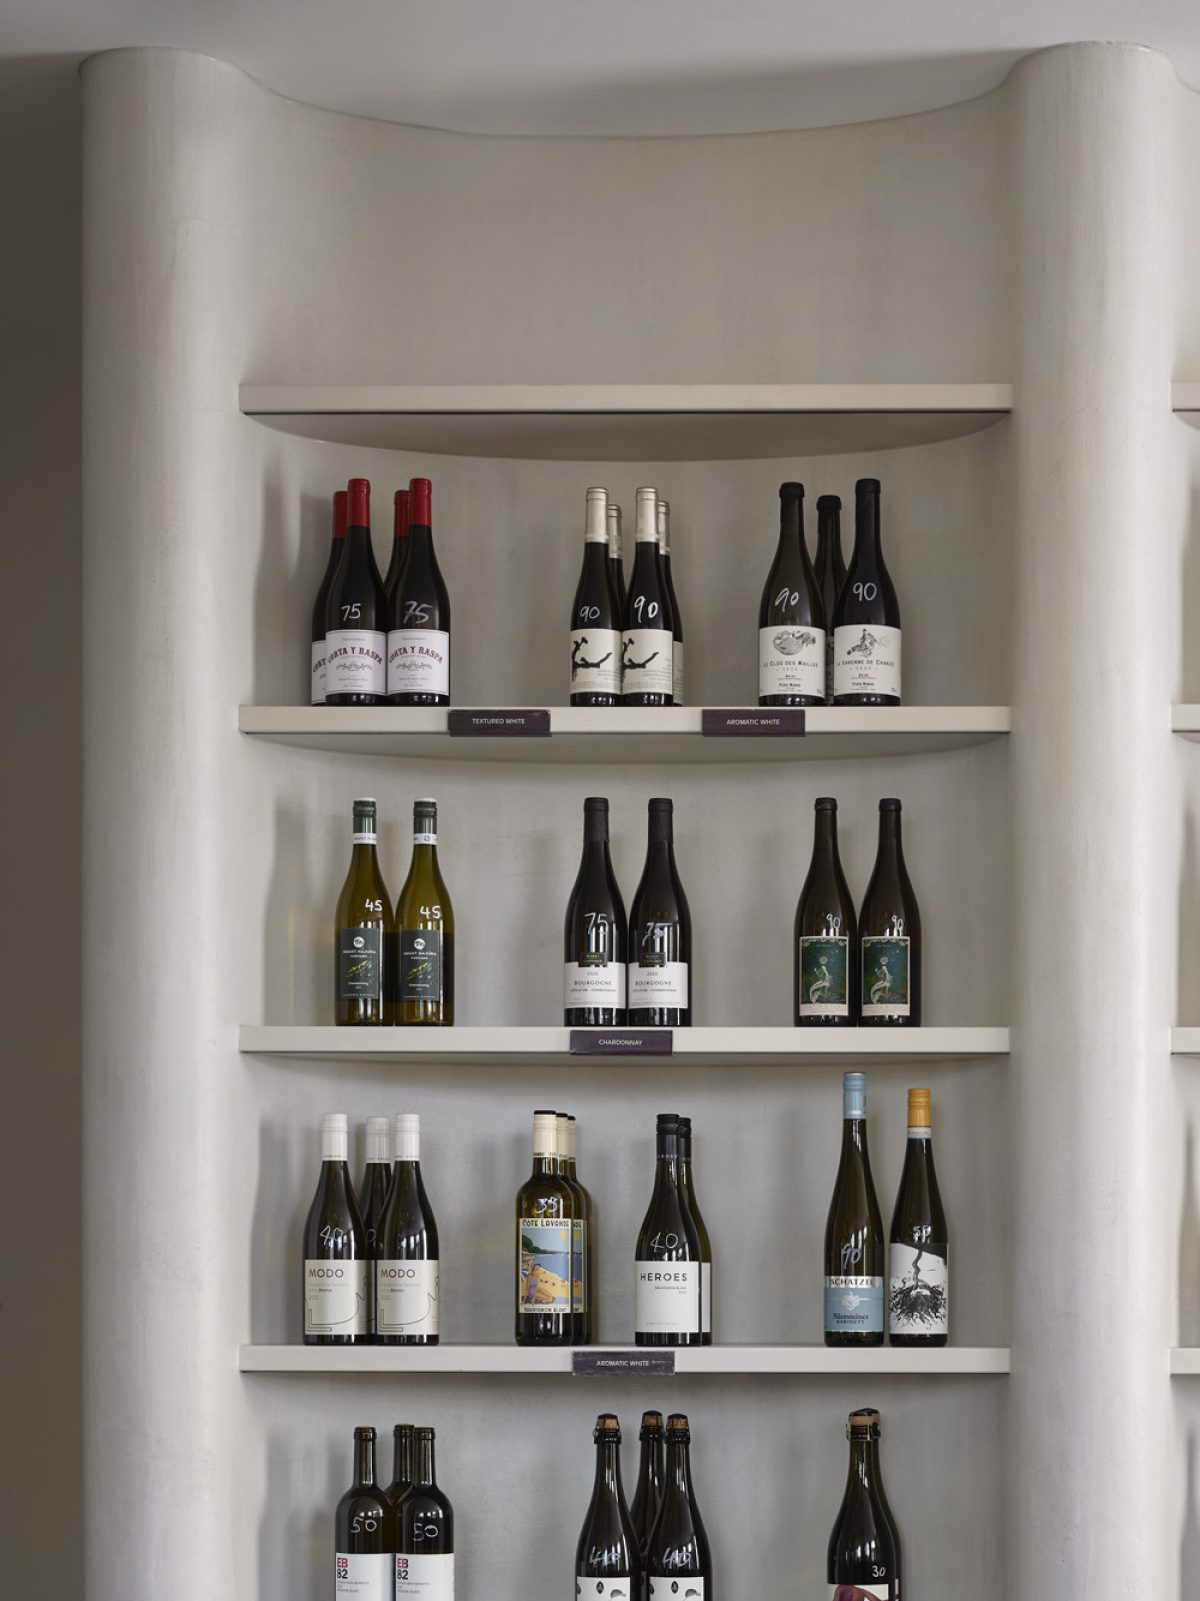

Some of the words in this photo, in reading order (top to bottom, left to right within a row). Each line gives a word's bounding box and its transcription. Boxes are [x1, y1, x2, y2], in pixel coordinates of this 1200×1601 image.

[852, 582, 877, 602] 90
[774, 587, 799, 613] 90
[341, 603, 362, 621] 75
[403, 600, 432, 624] 75
[580, 606, 601, 622] 90
[634, 595, 659, 623] 90
[726, 718, 759, 726] AROMATIC
[760, 718, 780, 726] WHITE
[365, 898, 383, 912] 45
[419, 905, 441, 919] 45
[650, 1231, 679, 1253] 40
[308, 1268, 344, 1279] MODO
[380, 1268, 416, 1279] MODO
[640, 1272, 688, 1281] HEROES
[350, 1516, 378, 1534] 50
[412, 1522, 439, 1542] 50
[336, 1557, 349, 1568] EB
[396, 1557, 409, 1569] EB
[871, 1565, 886, 1578] 30
